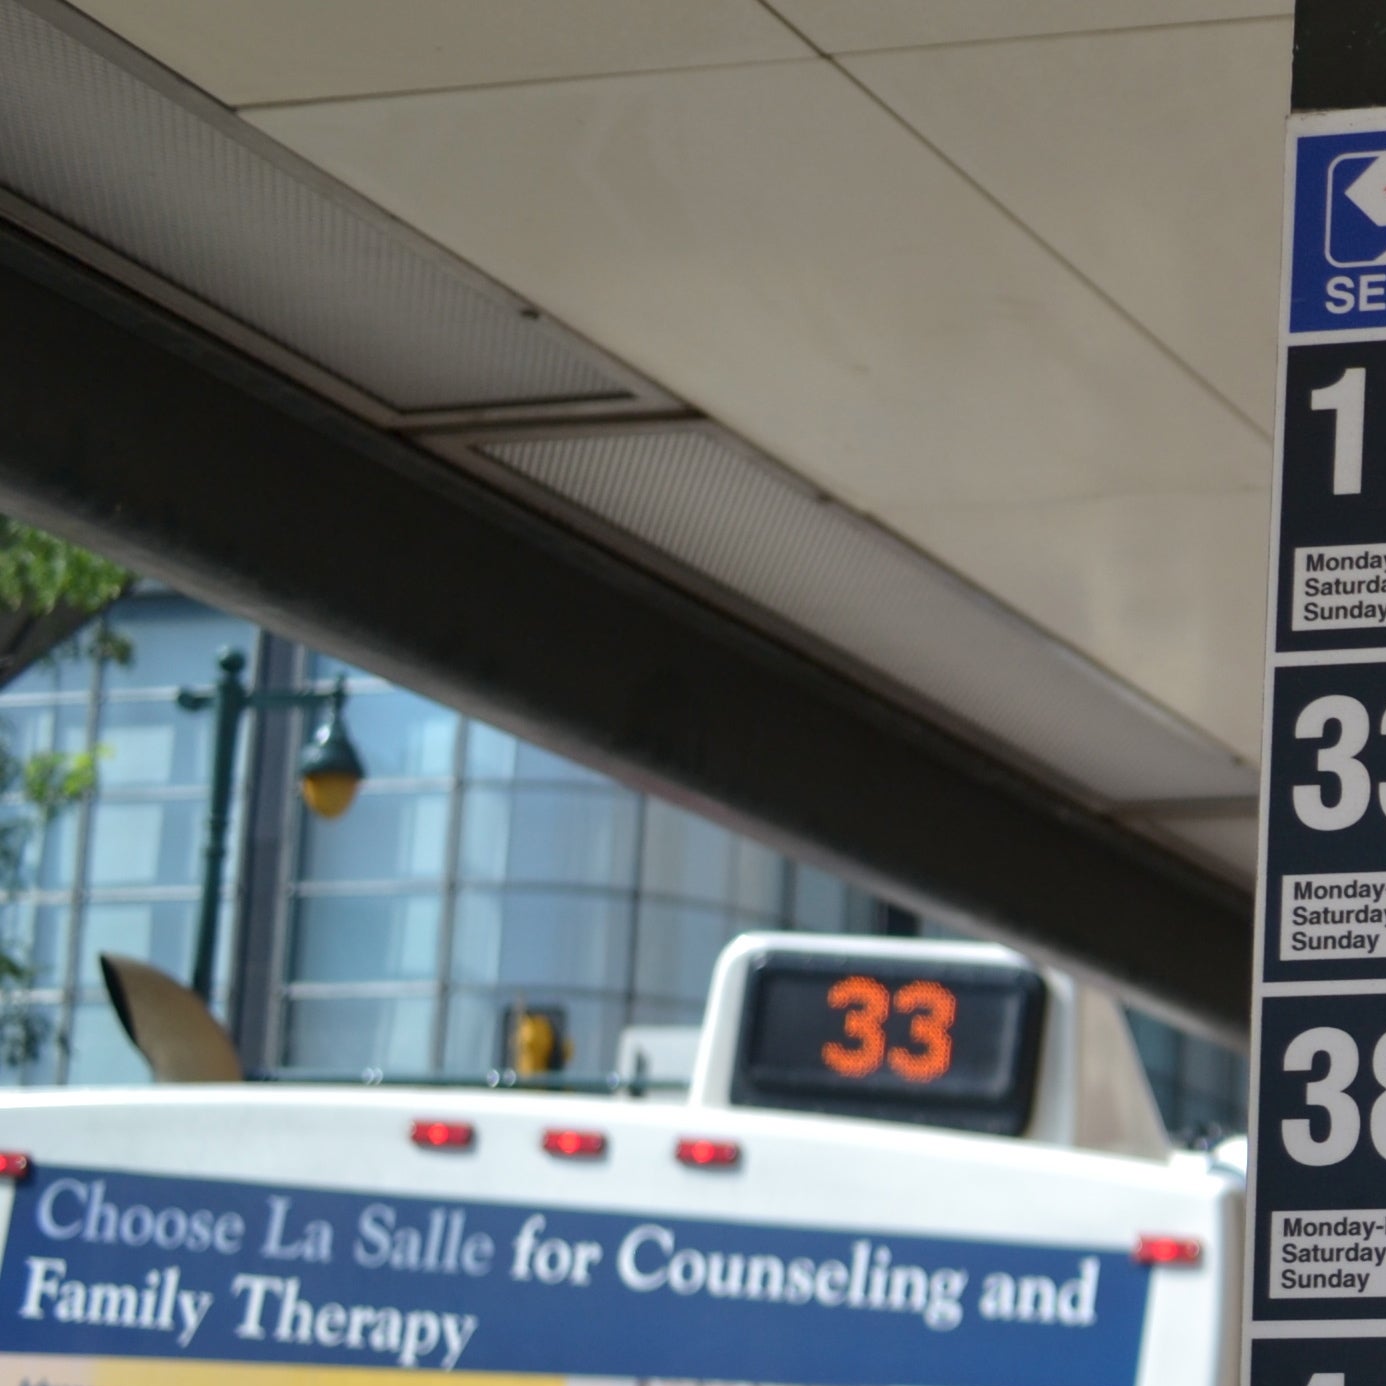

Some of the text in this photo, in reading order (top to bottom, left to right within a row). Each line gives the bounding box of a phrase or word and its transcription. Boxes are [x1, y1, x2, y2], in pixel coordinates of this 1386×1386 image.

[1291, 930, 1381, 954] Sunday
[821, 975, 957, 1083] 33
[36, 1178, 1099, 1332] Choose La Salle for Counseling and
[1281, 1268, 1371, 1293] Sunday
[20, 1256, 478, 1371] Family Therapy
